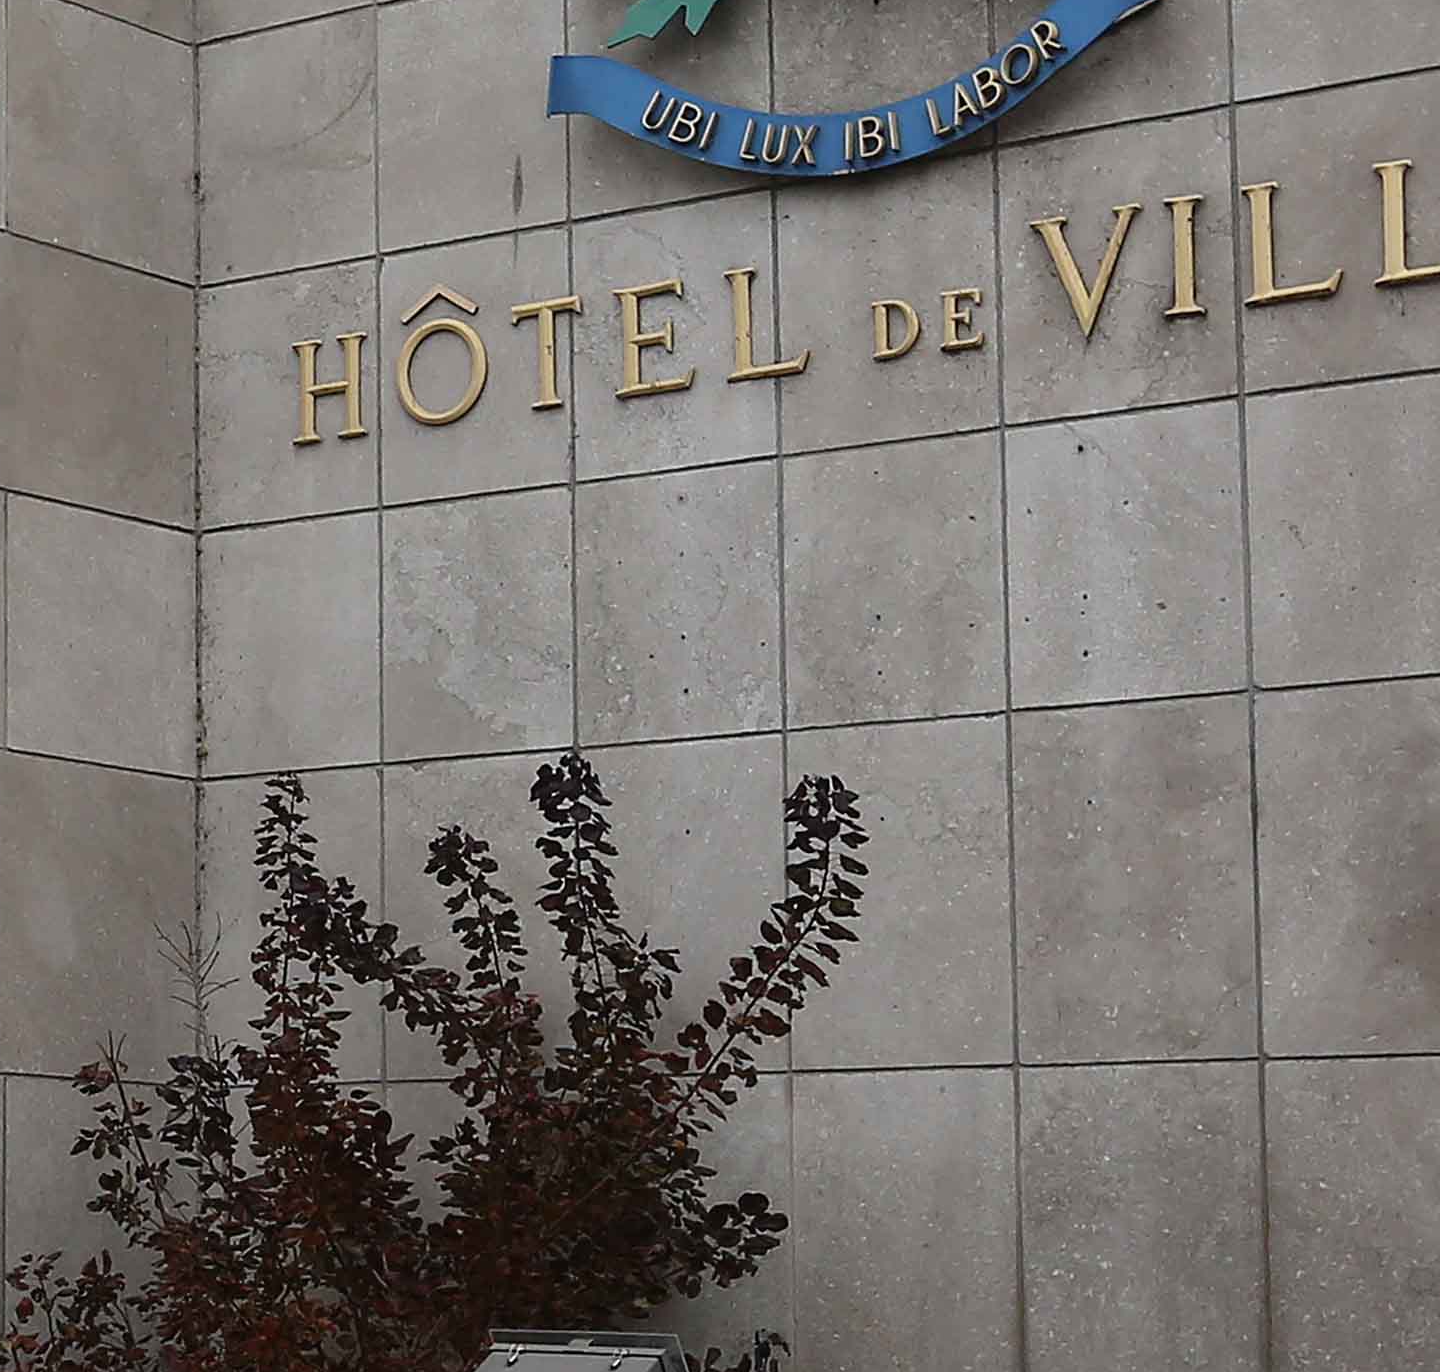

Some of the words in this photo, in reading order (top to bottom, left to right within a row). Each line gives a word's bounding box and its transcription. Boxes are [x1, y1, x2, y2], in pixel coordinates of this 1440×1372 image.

[640, 88, 719, 150] UBI
[739, 117, 818, 167] LUX
[844, 110, 903, 161] IBI
[924, 19, 1065, 137] LABOR
[290, 265, 810, 447] HÔTEL
[869, 287, 985, 363] DE
